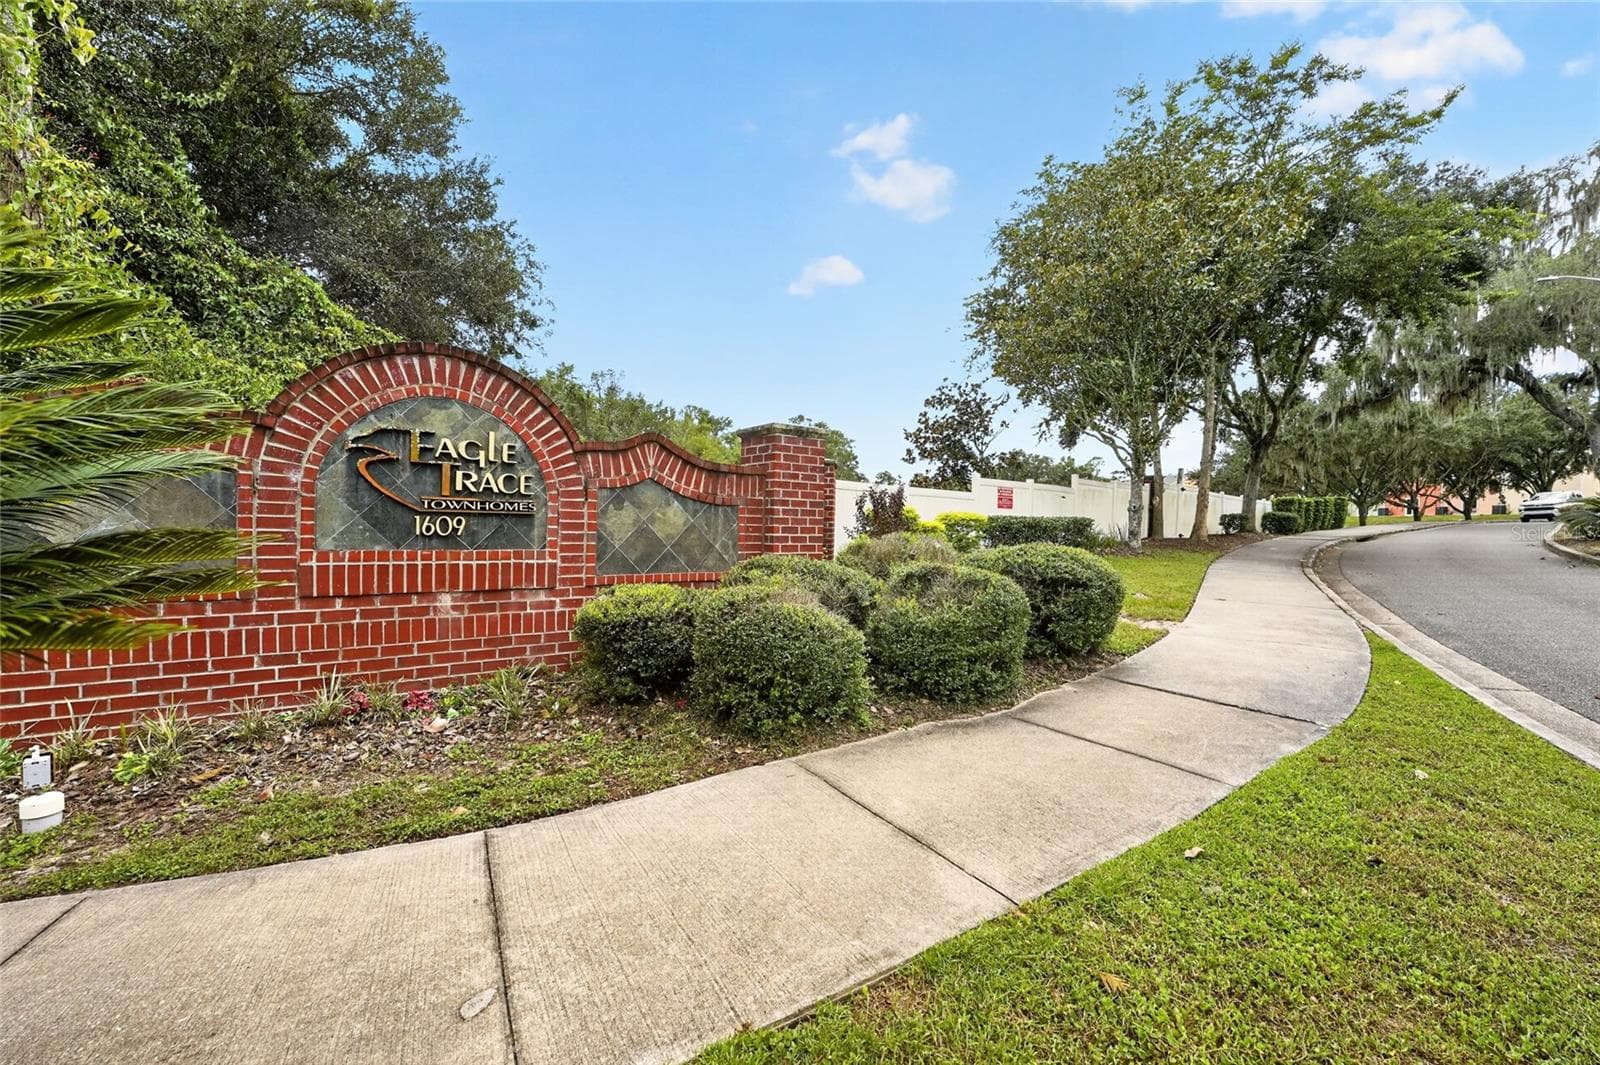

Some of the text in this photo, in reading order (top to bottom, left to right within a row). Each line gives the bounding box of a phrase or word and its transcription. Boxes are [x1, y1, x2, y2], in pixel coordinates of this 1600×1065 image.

[428, 461, 536, 497] TRACE
[420, 499, 537, 512] TOWNHOMES
[414, 515, 466, 536] 1609
